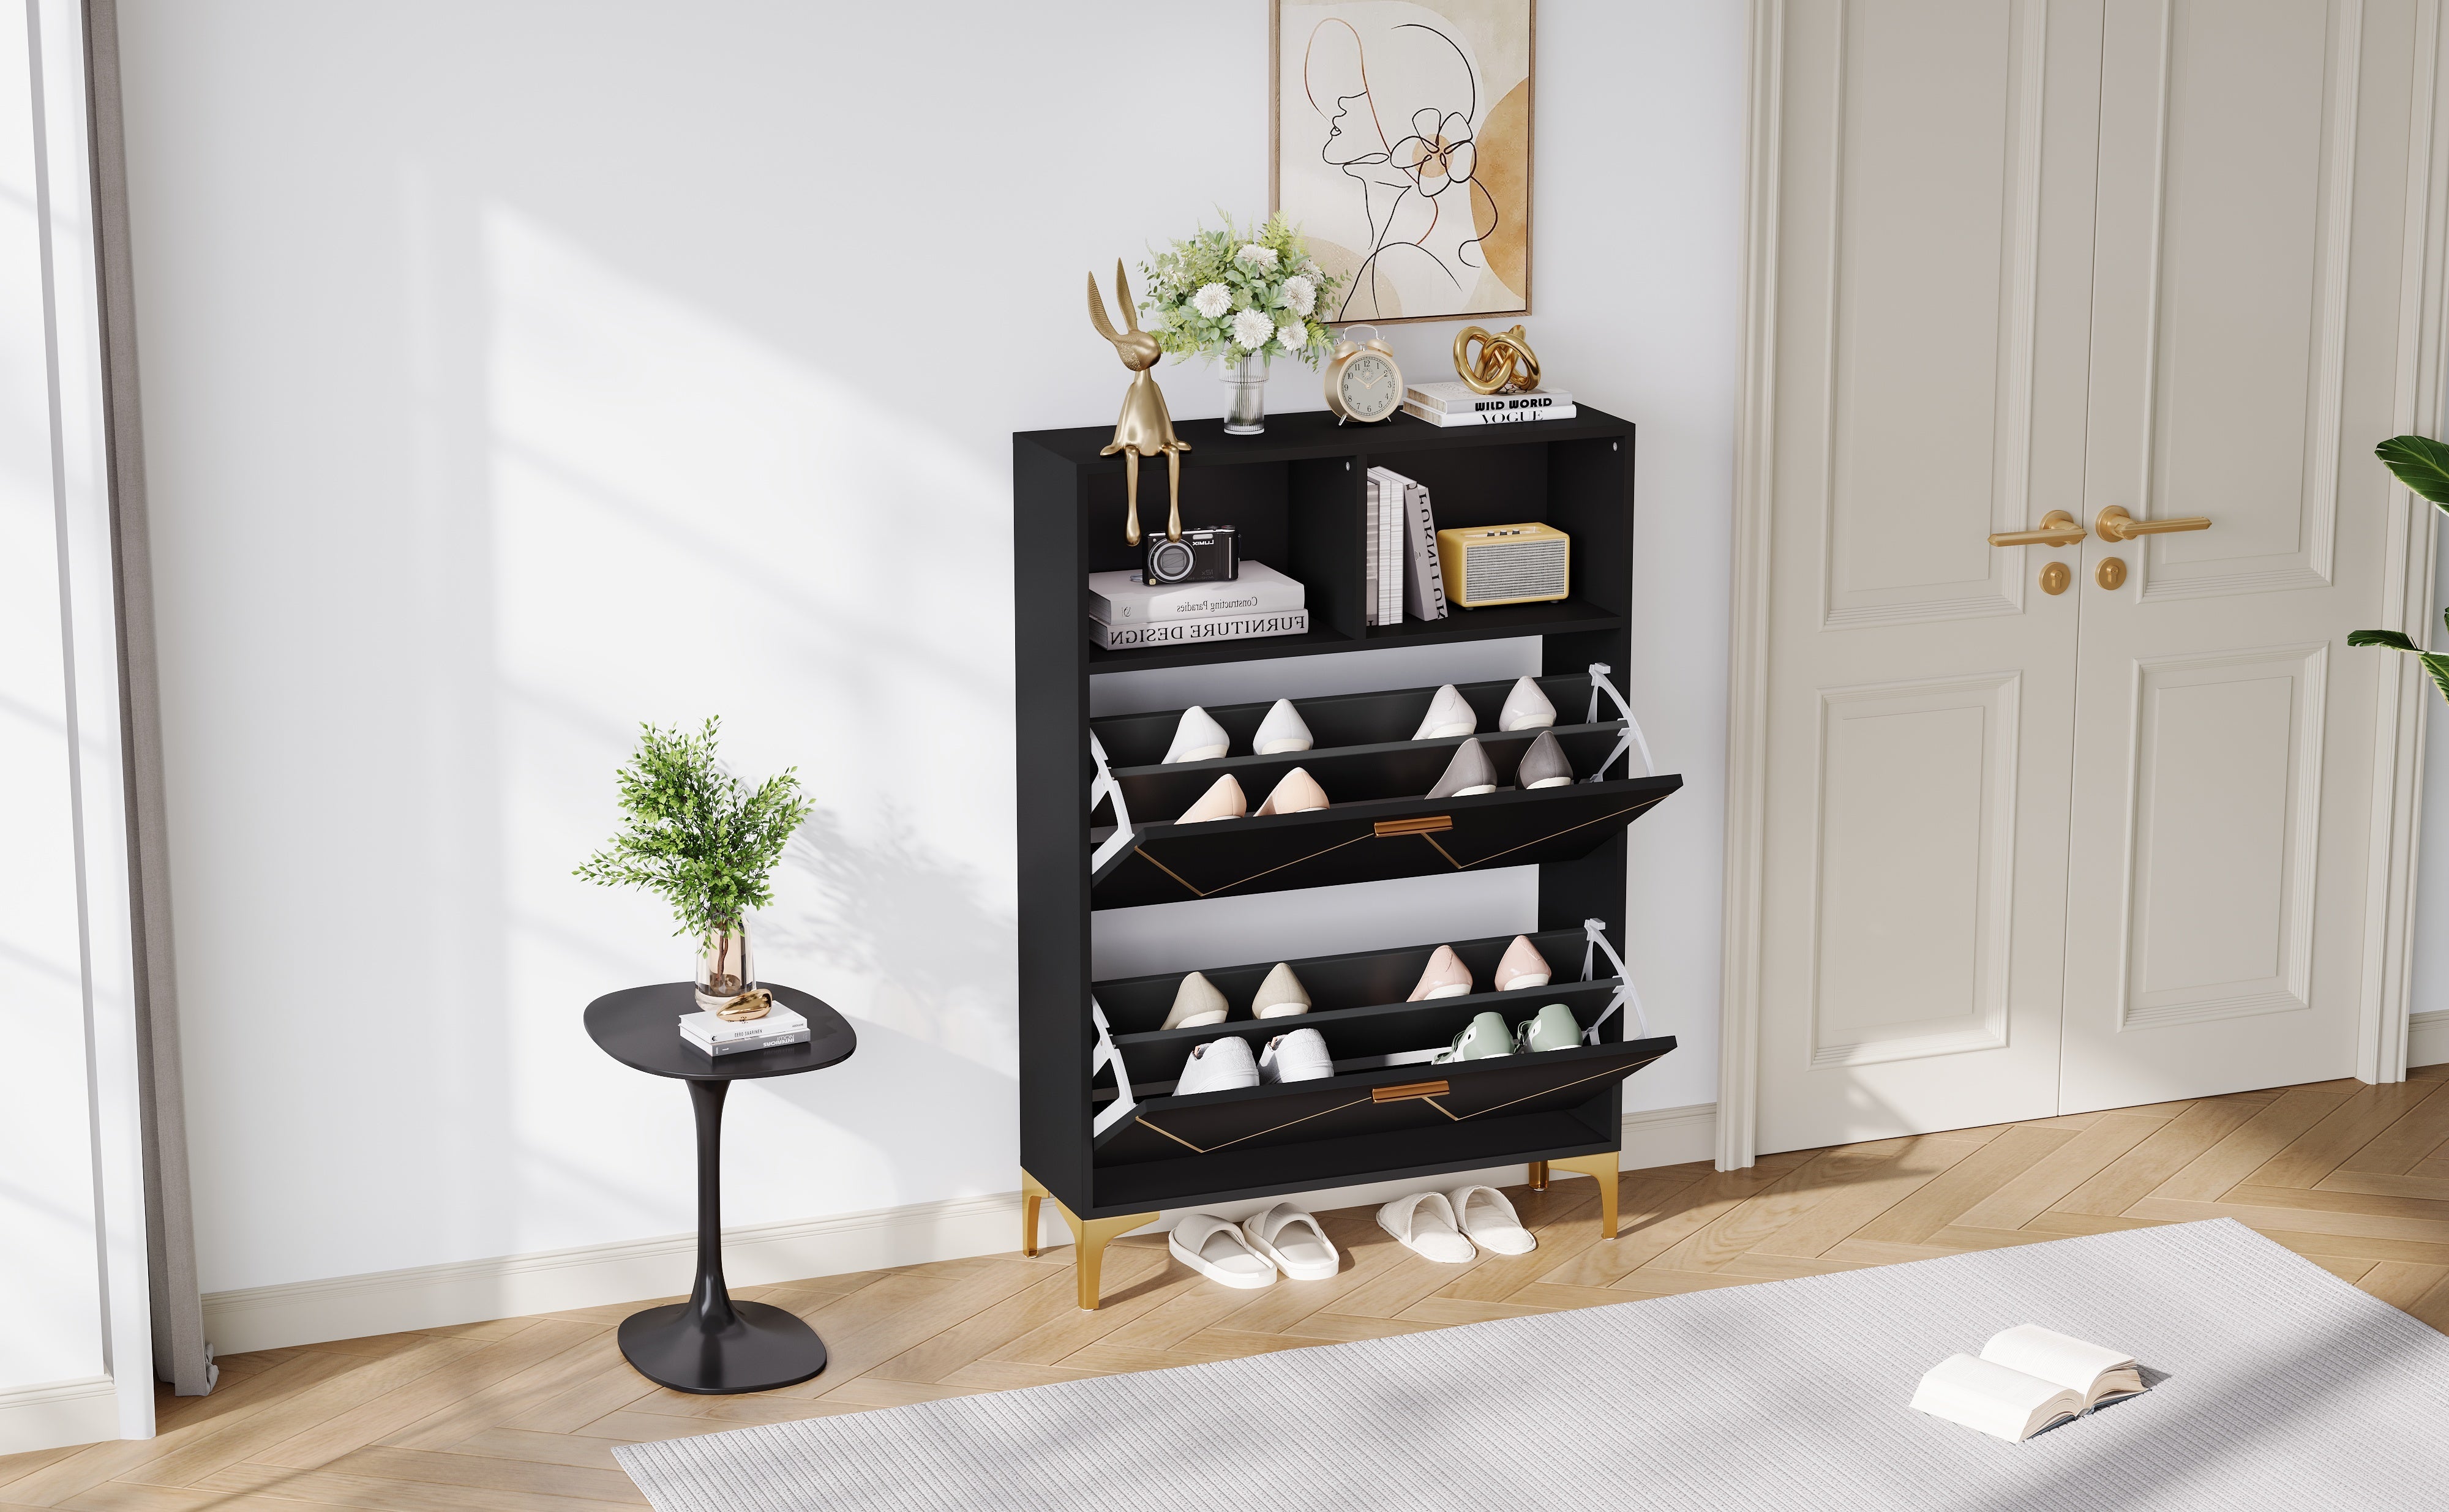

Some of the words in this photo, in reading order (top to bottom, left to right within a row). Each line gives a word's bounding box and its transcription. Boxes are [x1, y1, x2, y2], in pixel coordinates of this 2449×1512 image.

[1475, 401, 1505, 411] WILD
[1509, 398, 1552, 409] WORLD
[1482, 410, 1543, 424] VOGUE
[763, 1038, 794, 1047] INTERIORS
